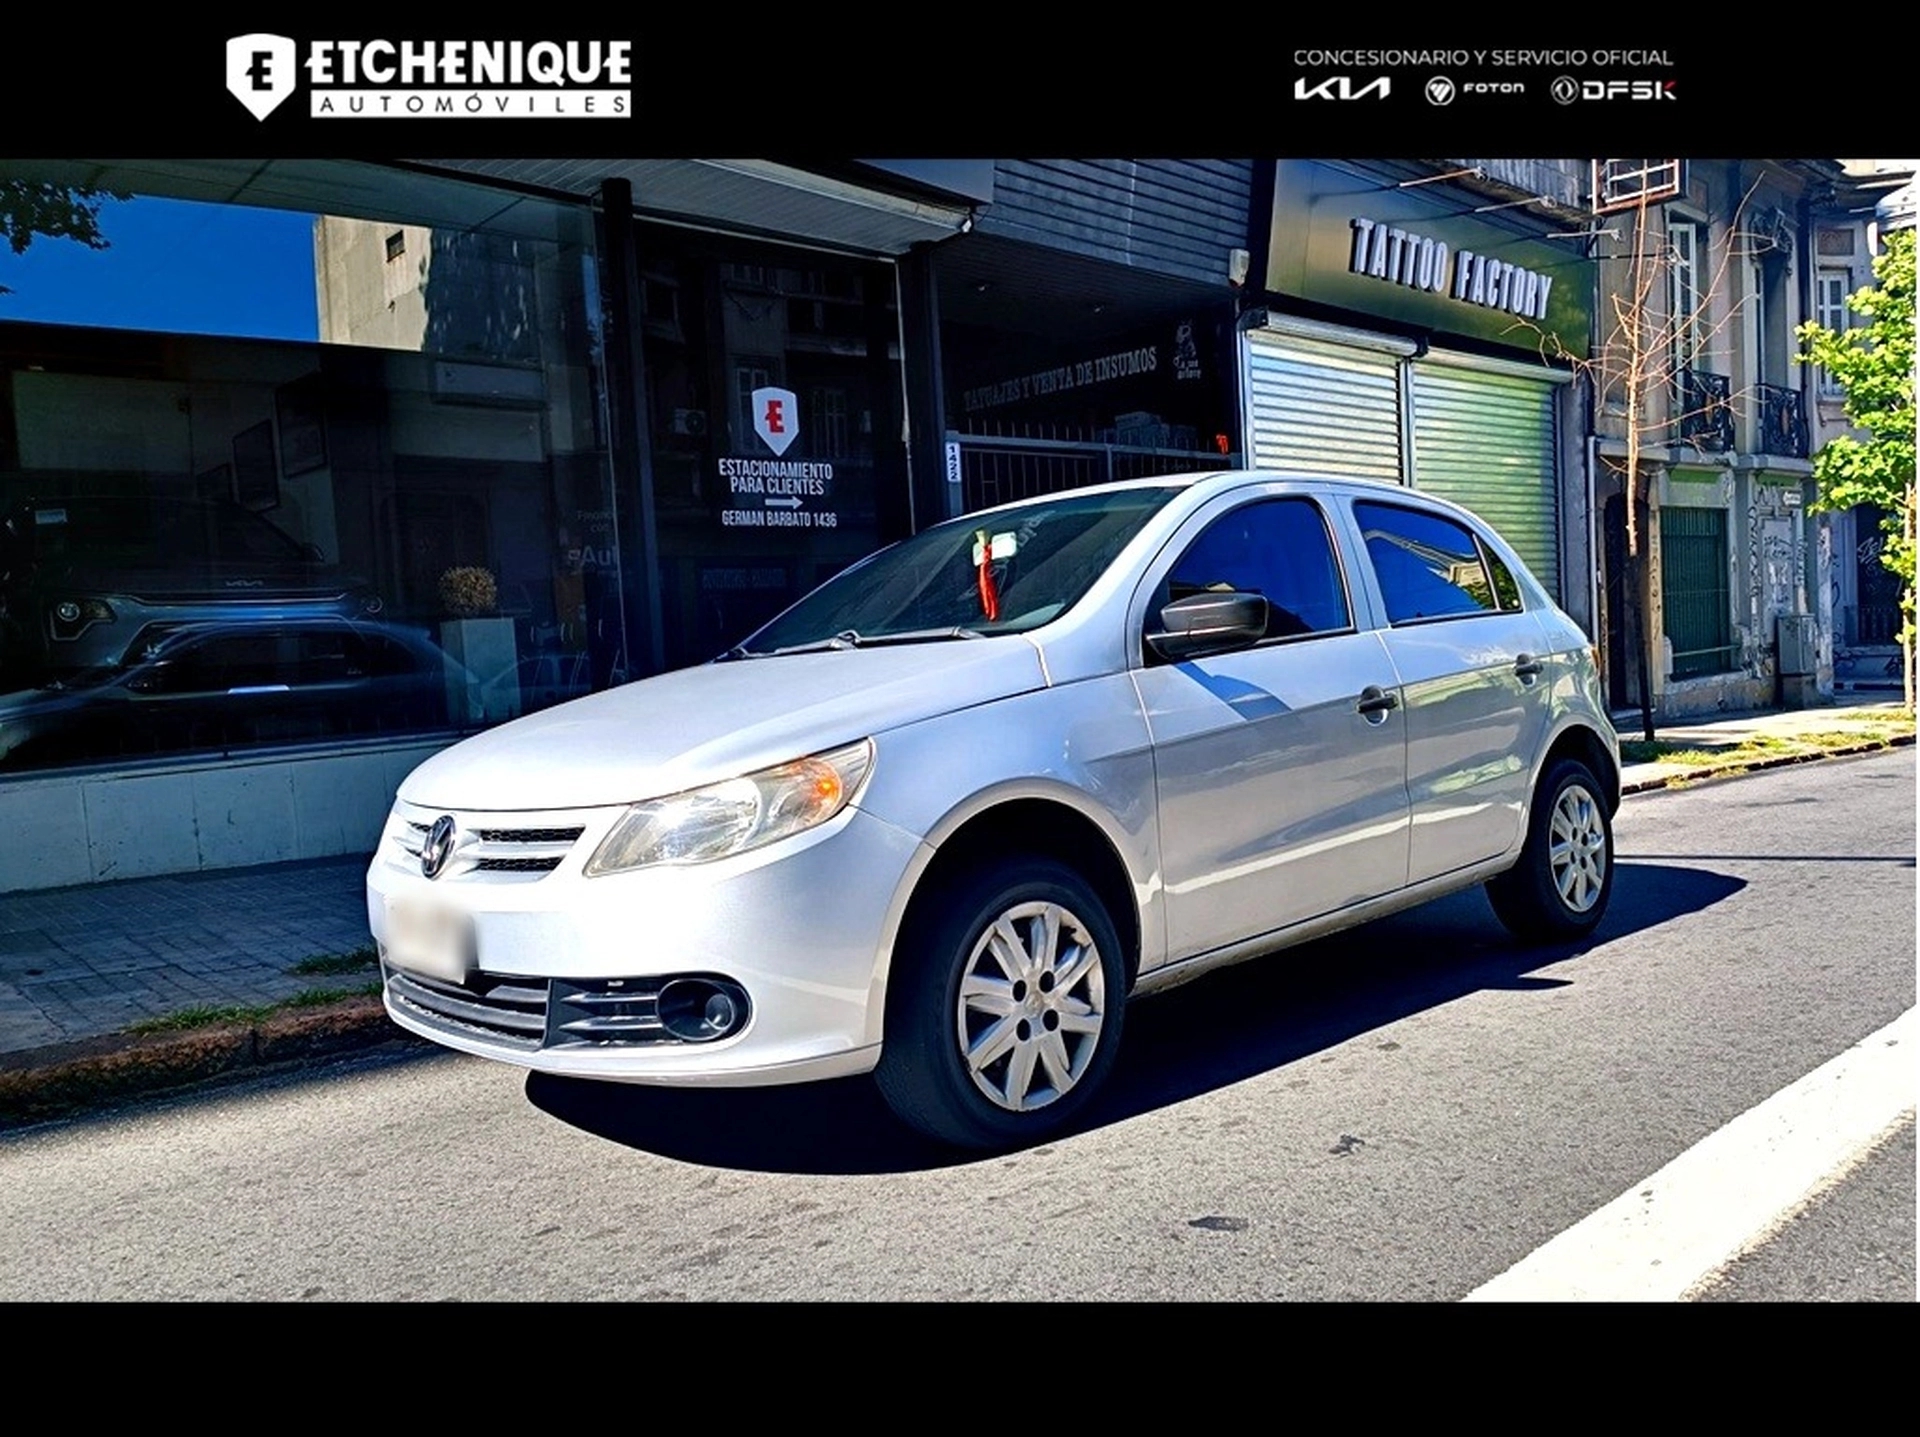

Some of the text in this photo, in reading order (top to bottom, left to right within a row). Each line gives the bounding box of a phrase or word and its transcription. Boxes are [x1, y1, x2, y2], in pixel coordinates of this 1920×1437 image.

[1352, 218, 1553, 320] TATTOO FACTORY
[1021, 376, 1030, 399] Y
[1032, 365, 1074, 395] VENTA
[1076, 360, 1093, 386] DE
[1095, 346, 1158, 381] INSUMOS
[718, 458, 833, 479] ESTACIONAMIENTO
[731, 476, 825, 495] PARA CLIENTES
[722, 510, 838, 528] GERMAN BARBATO 1436
